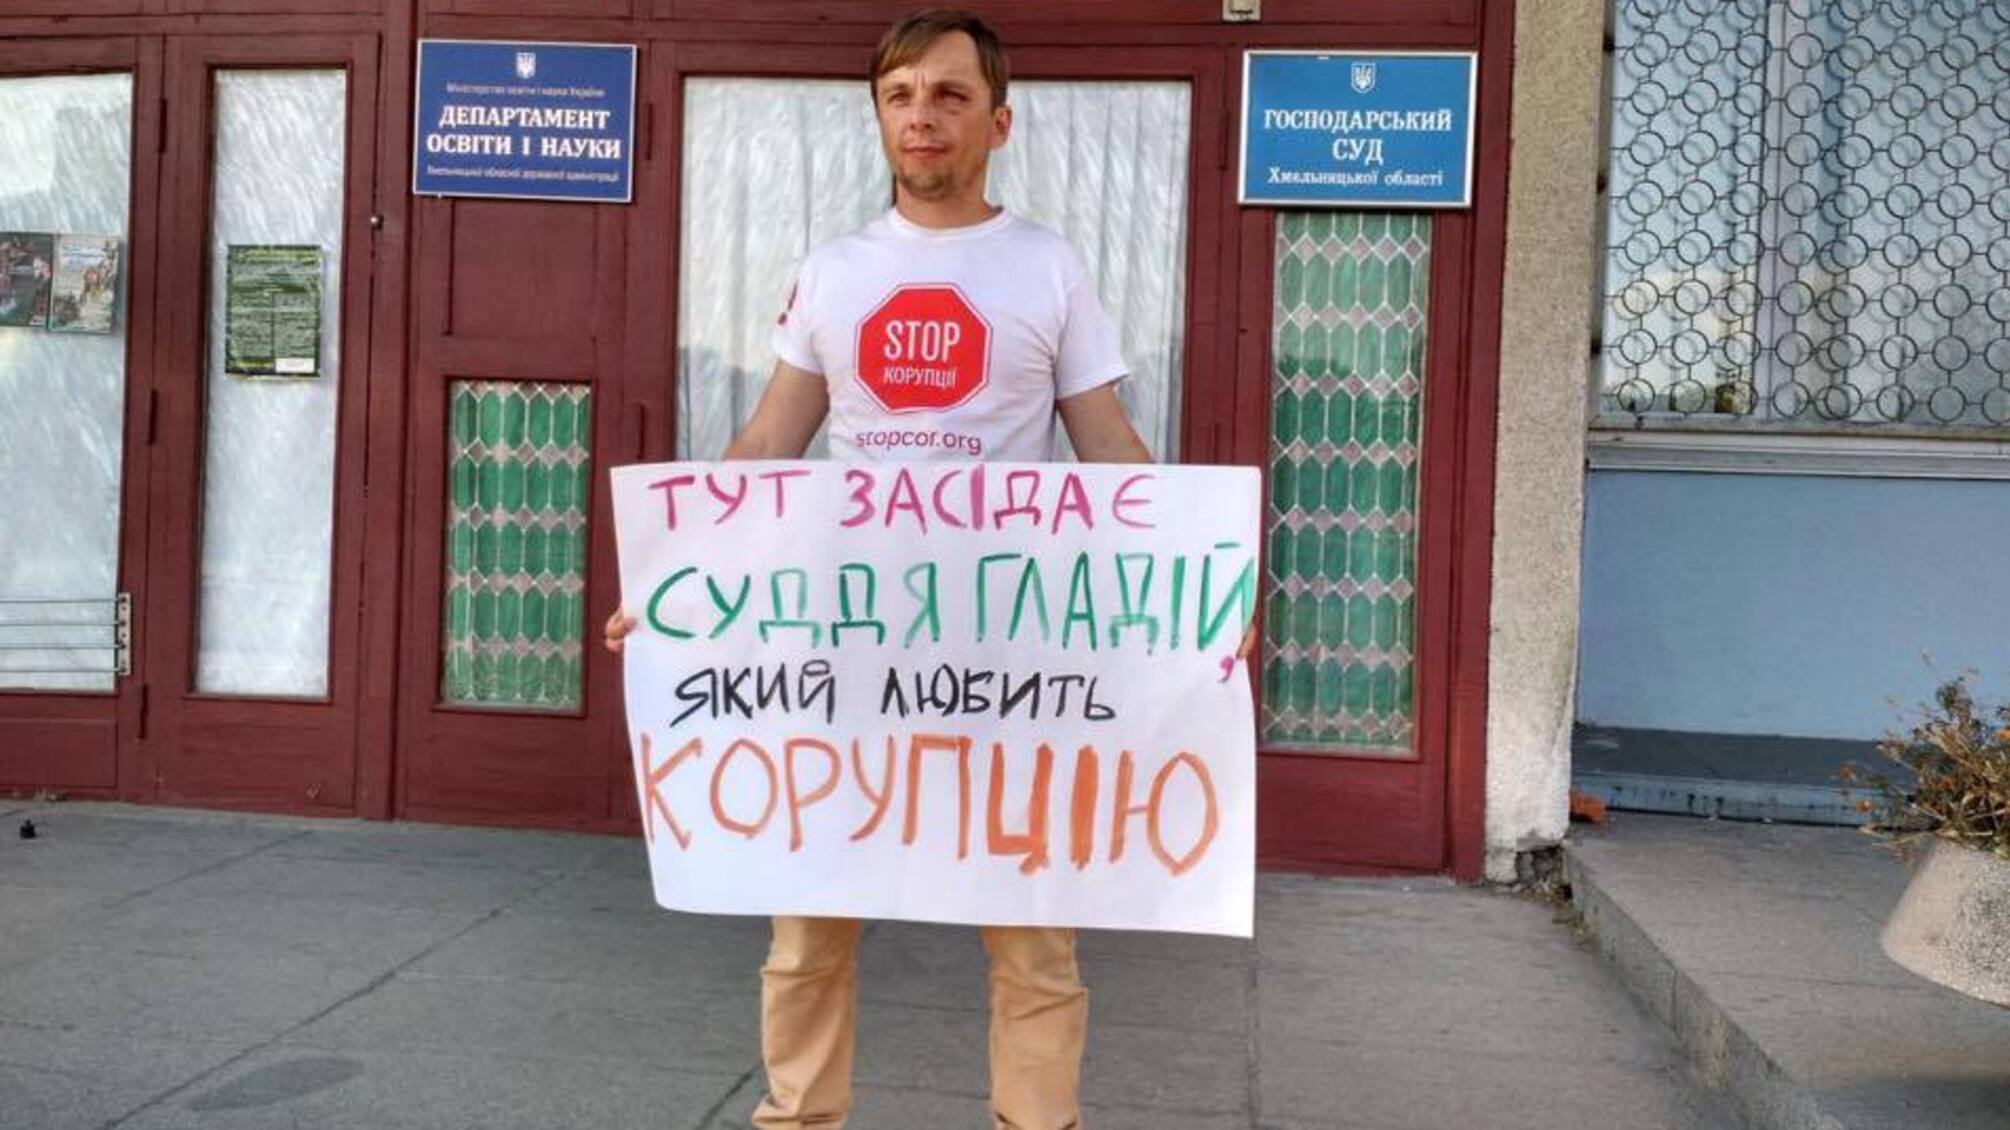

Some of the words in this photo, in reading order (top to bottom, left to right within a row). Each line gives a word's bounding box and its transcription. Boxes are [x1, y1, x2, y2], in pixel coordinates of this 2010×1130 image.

[439, 105, 611, 129] ДЕПАРТАМЕНТ
[1264, 109, 1452, 133] ГОСПОДАРСЬКИЙ
[426, 133, 512, 155] ОСВІТИ
[522, 136, 530, 156] І
[541, 138, 622, 159] НАУКИ
[1332, 138, 1384, 166] СУД
[1268, 166, 1378, 187] Хмельницької
[1384, 169, 1443, 187] області
[884, 320, 961, 363] STOP
[883, 366, 956, 389] КОРУПЦІЇ
[856, 430, 982, 456] stopcor.org
[648, 469, 811, 531] ТУТ
[839, 465, 1157, 534] ЗАСІДАЄ
[646, 561, 942, 649] СУДДЯ
[669, 659, 836, 726] ЯКИЙ
[881, 663, 1117, 723] ЛЮБИТЬ
[641, 733, 1220, 877] КОРУПЦІЮ
